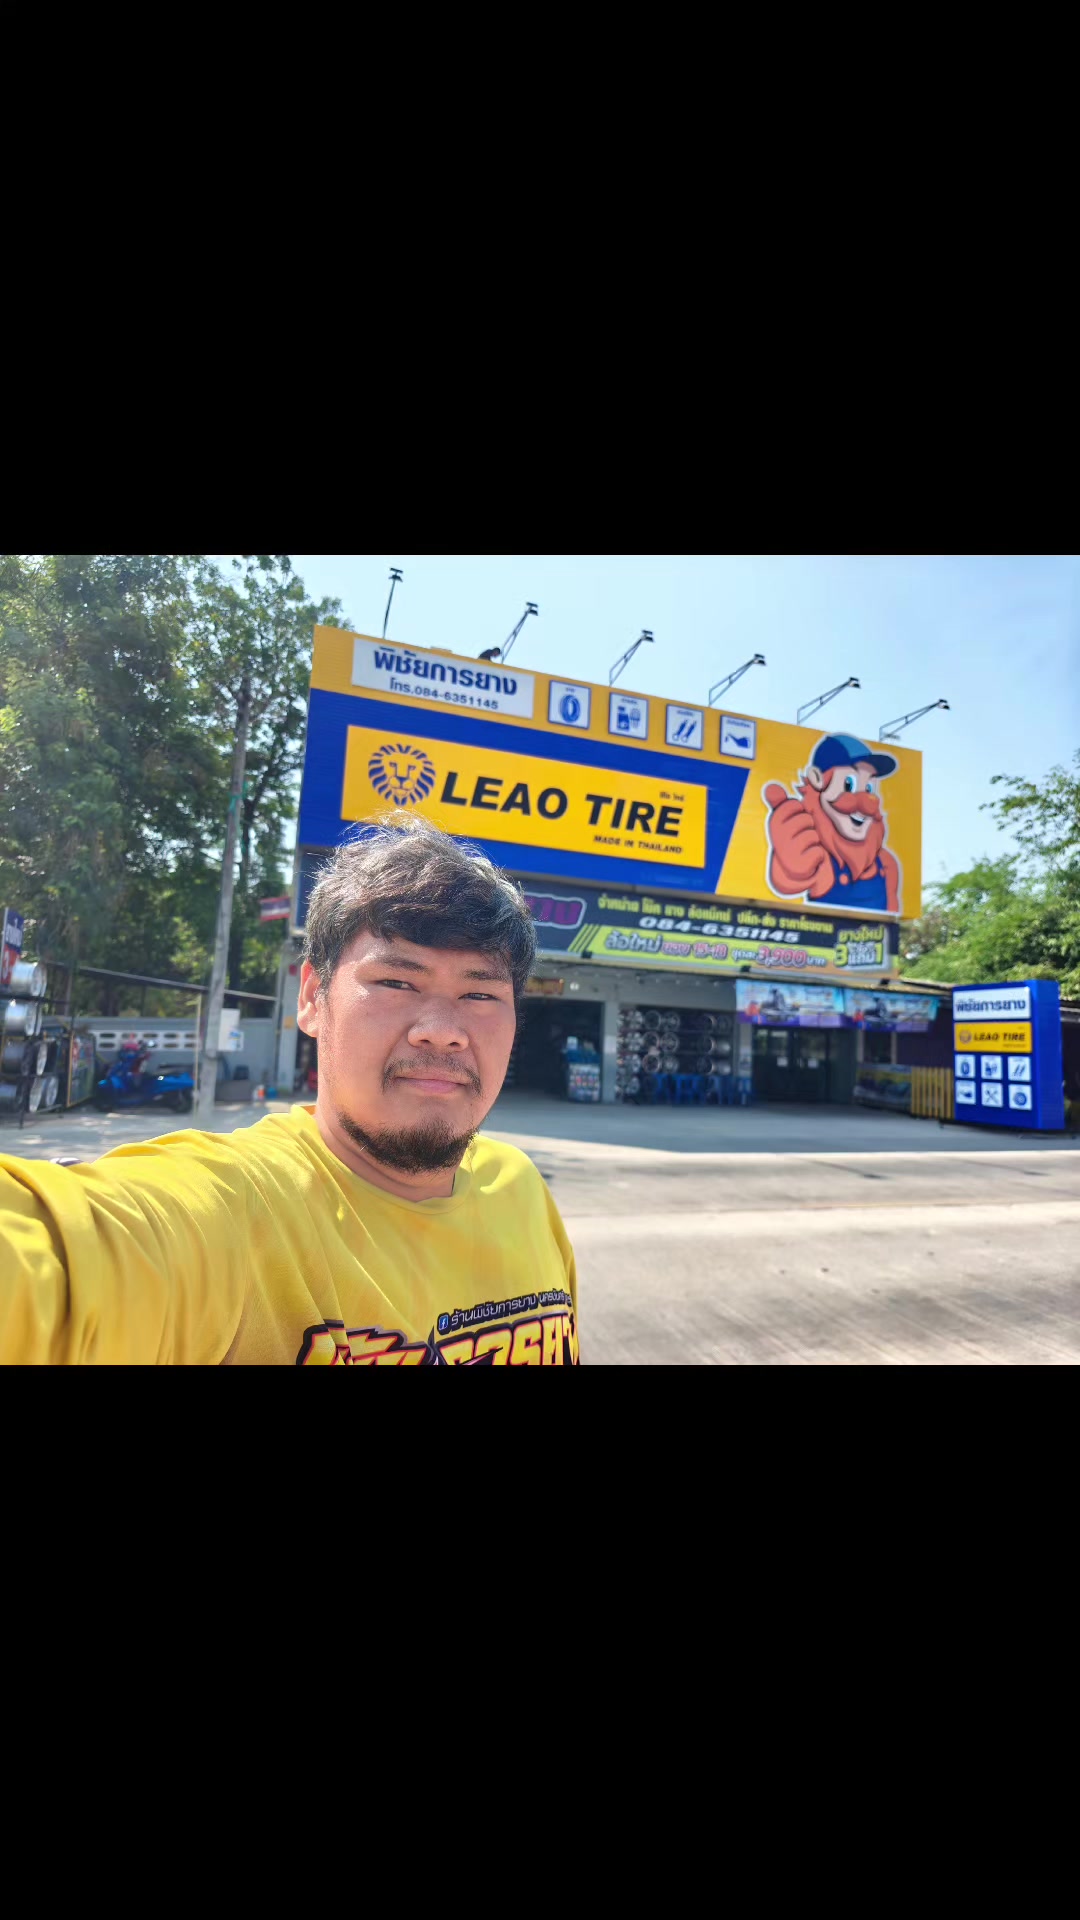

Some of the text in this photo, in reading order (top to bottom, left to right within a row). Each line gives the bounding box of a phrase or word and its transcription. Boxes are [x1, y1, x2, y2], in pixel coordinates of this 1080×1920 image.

[373, 646, 517, 696] พิชัยการยาง
[440, 771, 683, 838] LEAO TIRE
[593, 835, 683, 854] MADE IN THAILAND
[639, 916, 800, 943] 084-6351145
[973, 1032, 1025, 1041] LEAO TIRE
[451, 1295, 536, 1326] ร้านพิชัยการยาง
